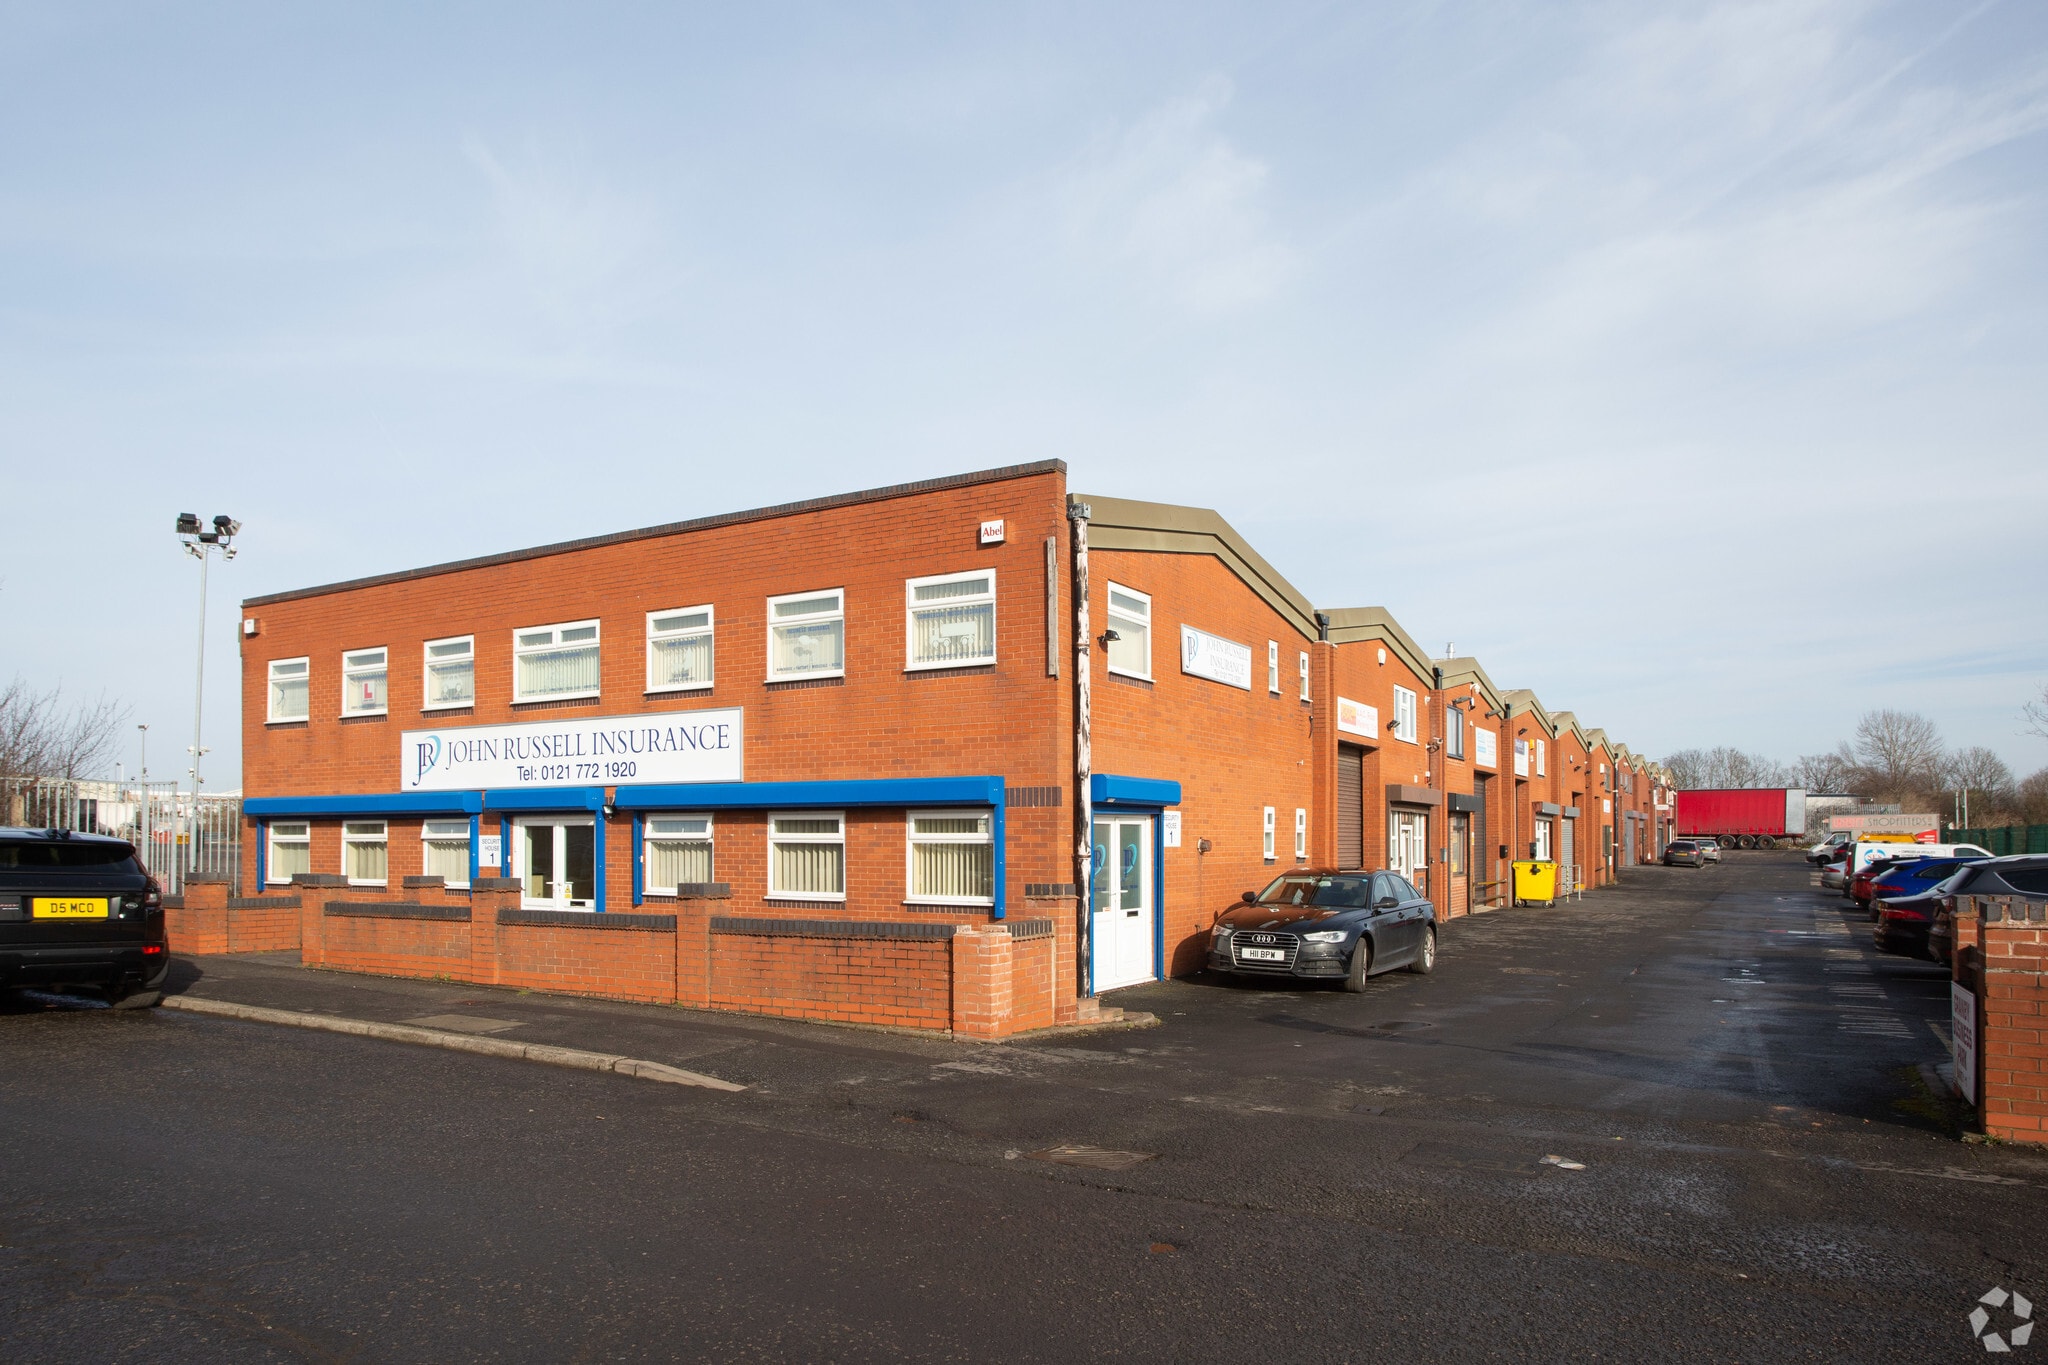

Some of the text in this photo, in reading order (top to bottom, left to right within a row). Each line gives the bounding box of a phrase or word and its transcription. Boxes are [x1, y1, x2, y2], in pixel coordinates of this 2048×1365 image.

[983, 525, 1002, 537] Abel
[364, 683, 373, 699] L
[445, 724, 730, 770] JOHN RUSSELL INSURANCE
[516, 761, 637, 781] Tel: 0121 772 1920
[1868, 817, 1927, 827] SHOPFITTERS
[50, 903, 94, 913] D5 MCO
[1260, 950, 1276, 959] BPW
